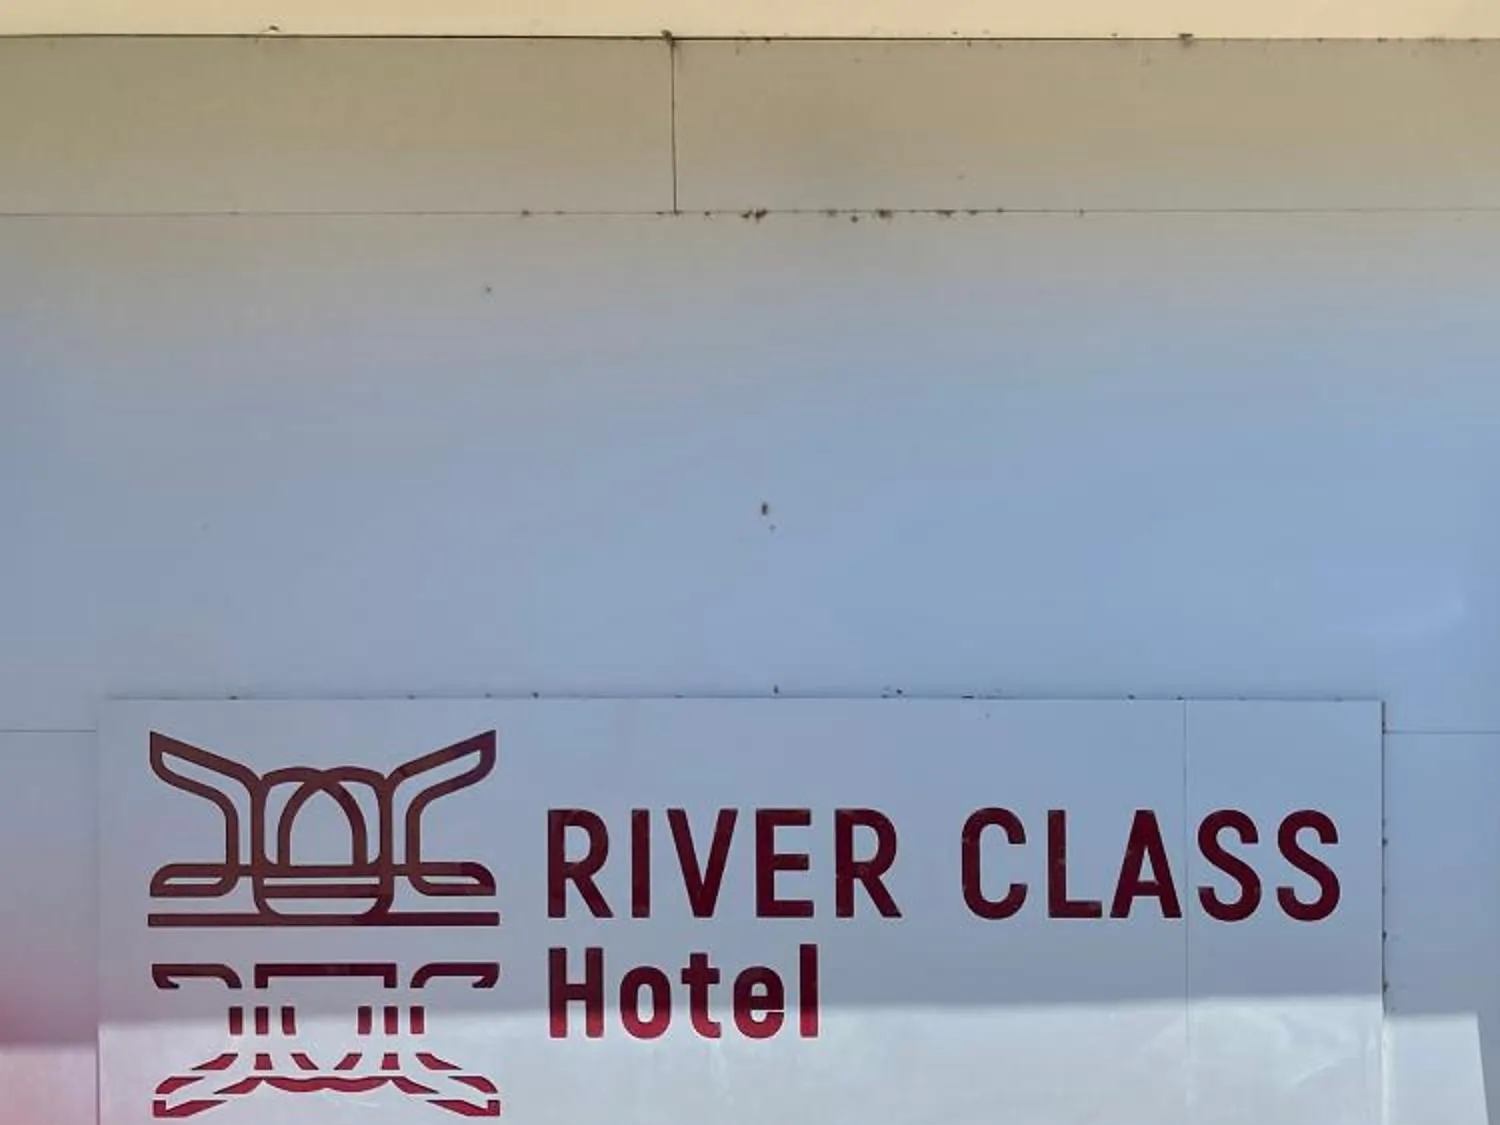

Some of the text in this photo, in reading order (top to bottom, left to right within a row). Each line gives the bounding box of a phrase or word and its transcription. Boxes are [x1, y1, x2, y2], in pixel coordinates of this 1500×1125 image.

[547, 807, 1341, 923] RIVER CLASS
[547, 943, 819, 1039] Hotel
